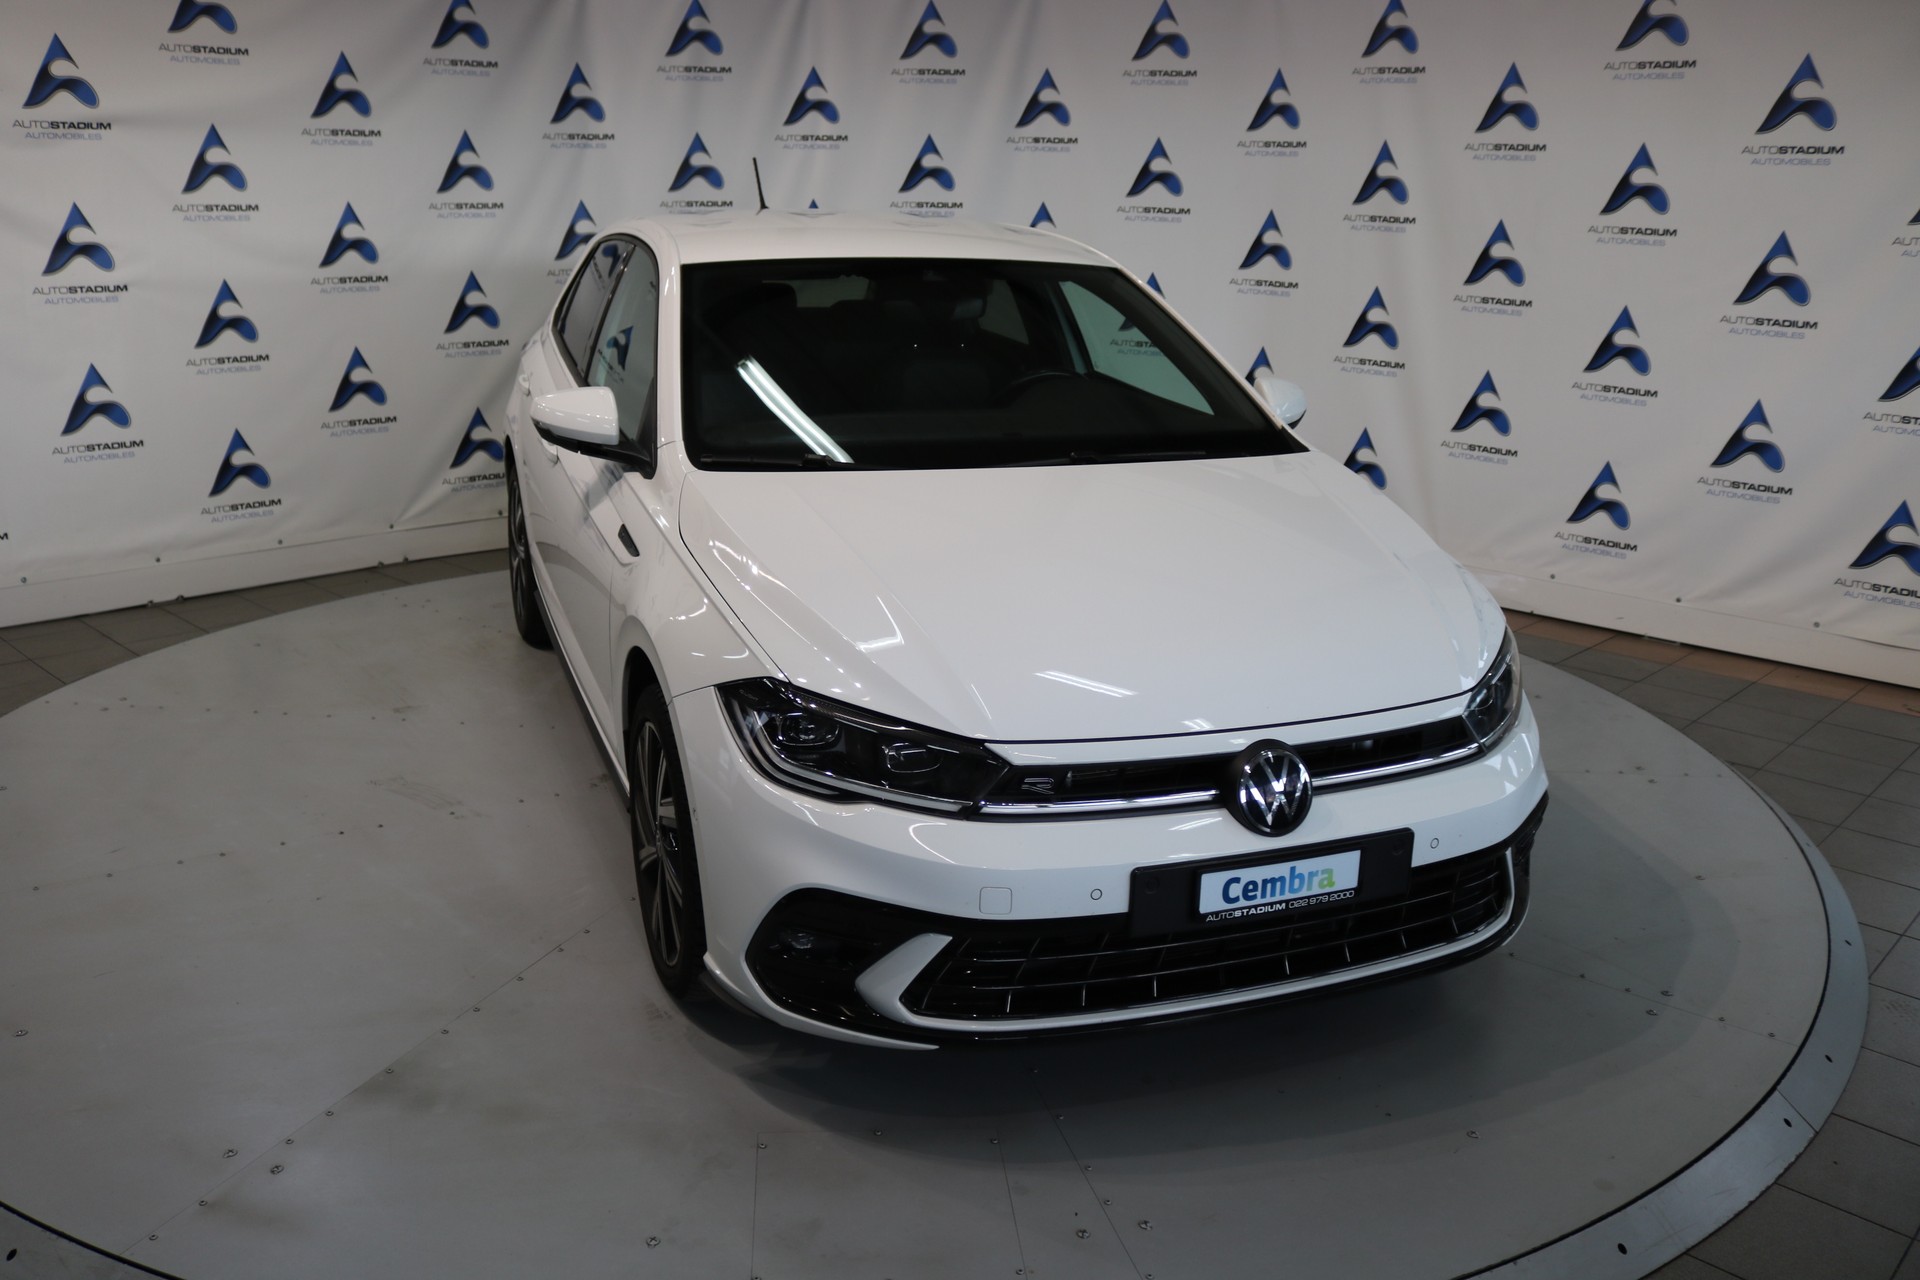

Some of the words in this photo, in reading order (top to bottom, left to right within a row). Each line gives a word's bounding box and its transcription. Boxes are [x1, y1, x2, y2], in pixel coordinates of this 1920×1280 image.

[159, 43, 249, 57] AUTOSTADIUM
[170, 55, 240, 65] AUTOMOBILES
[423, 57, 498, 70] AUTOSTADIUM
[1604, 60, 1697, 70] AUTOSTADIUM
[431, 67, 490, 76] AUTOMOBILES
[657, 65, 732, 74] AUTOSTADIUM
[891, 68, 966, 76] AUTOSTADIUM
[1123, 69, 1197, 78] AUTOSTADIUM
[1352, 65, 1426, 75] AUTOSTADIUM
[1360, 76, 1418, 84] AUTOMOBILES
[1612, 71, 1685, 80] AUTOMOBILES
[899, 77, 957, 85] AUTOMOBILES
[1130, 78, 1189, 86] AUTOMOBILES
[13, 119, 111, 131] AUTOSTADIUM
[25, 131, 102, 141] AUTOMOBILES
[301, 128, 381, 138] AUTOSTADIUM
[542, 133, 615, 141] AUTOSTADIUM
[774, 134, 848, 142] AUTOSTADIUM
[310, 138, 373, 146] AUTOMOBILES
[550, 141, 608, 149] AUTOMOBILES
[1006, 136, 1078, 144] AUTOSTADIUM
[1237, 140, 1306, 149] AUTOSTADIUM
[1015, 145, 1070, 153] AUTOMOBILES
[1464, 143, 1546, 152] AUTOSTADIUM
[1742, 145, 1845, 156] AUTOSTADIUM
[1245, 149, 1299, 157] AUTOMOBILES
[1473, 153, 1536, 162] AUTOMOBILES
[1751, 156, 1832, 166] AUTOMOBILES
[173, 203, 259, 213] AUTOSTADIUM
[429, 202, 503, 211] AUTOSTADIUM
[660, 200, 733, 208] AUTOSTADIUM
[890, 201, 963, 209] AUTOSTADIUM
[436, 210, 496, 218] AUTOMOBILES
[1117, 205, 1191, 215] AUTOSTADIUM
[183, 213, 250, 222] AUTOMOBILES
[1125, 214, 1182, 223] AUTOMOBILES
[1343, 214, 1416, 225] AUTOSTADIUM
[1350, 224, 1407, 233] AUTOMOBILES
[1588, 226, 1677, 237] AUTOSTADIUM
[1597, 235, 1667, 247] AUTOMOBILES
[310, 275, 388, 285] AUTOSTADIUM
[1229, 278, 1299, 290] AUTOSTADIUM
[33, 284, 128, 296] AUTOSTADIUM
[320, 285, 380, 294] AUTOMOBILES
[1237, 288, 1290, 297] AUTOMOBILES
[44, 295, 119, 305] AUTOMOBILES
[1454, 294, 1532, 308] AUTOSTADIUM
[1461, 304, 1523, 317] AUTOMOBILES
[1720, 315, 1818, 331] AUTOSTADIUM
[1728, 326, 1806, 340] AUTOMOBILES
[436, 339, 509, 350] AUTOSTADIUM
[444, 349, 502, 358] AUTOMOBILES
[186, 354, 269, 367] AUTOSTADIUM
[1333, 354, 1405, 370] AUTOSTADIUM
[196, 365, 262, 375] AUTOMOBILES
[1341, 365, 1398, 377] AUTOMOBILES
[1572, 381, 1658, 398] AUTOSTADIUM
[1580, 392, 1647, 408] AUTOMOBILES
[321, 416, 397, 430] AUTOSTADIUM
[1863, 411, 1920, 426] AUTOST
[330, 427, 389, 438] AUTOMOBILES
[52, 439, 143, 455] AUTOSTADIUM
[1441, 439, 1518, 458] AUTOSTADIUM
[63, 452, 136, 464] AUTOMOBILES
[1448, 451, 1509, 466] AUTOMOBILES
[442, 473, 505, 486] AUTOSTADIU
[1697, 476, 1792, 495] AUTOSTADIUM
[1706, 487, 1781, 504] AUTOMOBILES
[201, 498, 281, 515] AUTOSTADIUM
[211, 510, 274, 523] AUTOMOBILES
[1554, 531, 1637, 553] AUTOSTADIUM
[1562, 542, 1628, 559] AUTOMOBILES
[1221, 865, 1336, 905] Cembra
[1206, 902, 1286, 922] AUTOSTADIUM
[1288, 898, 1309, 909] 022
[1309, 895, 1328, 905] 979
[1329, 890, 1355, 902] 2000
